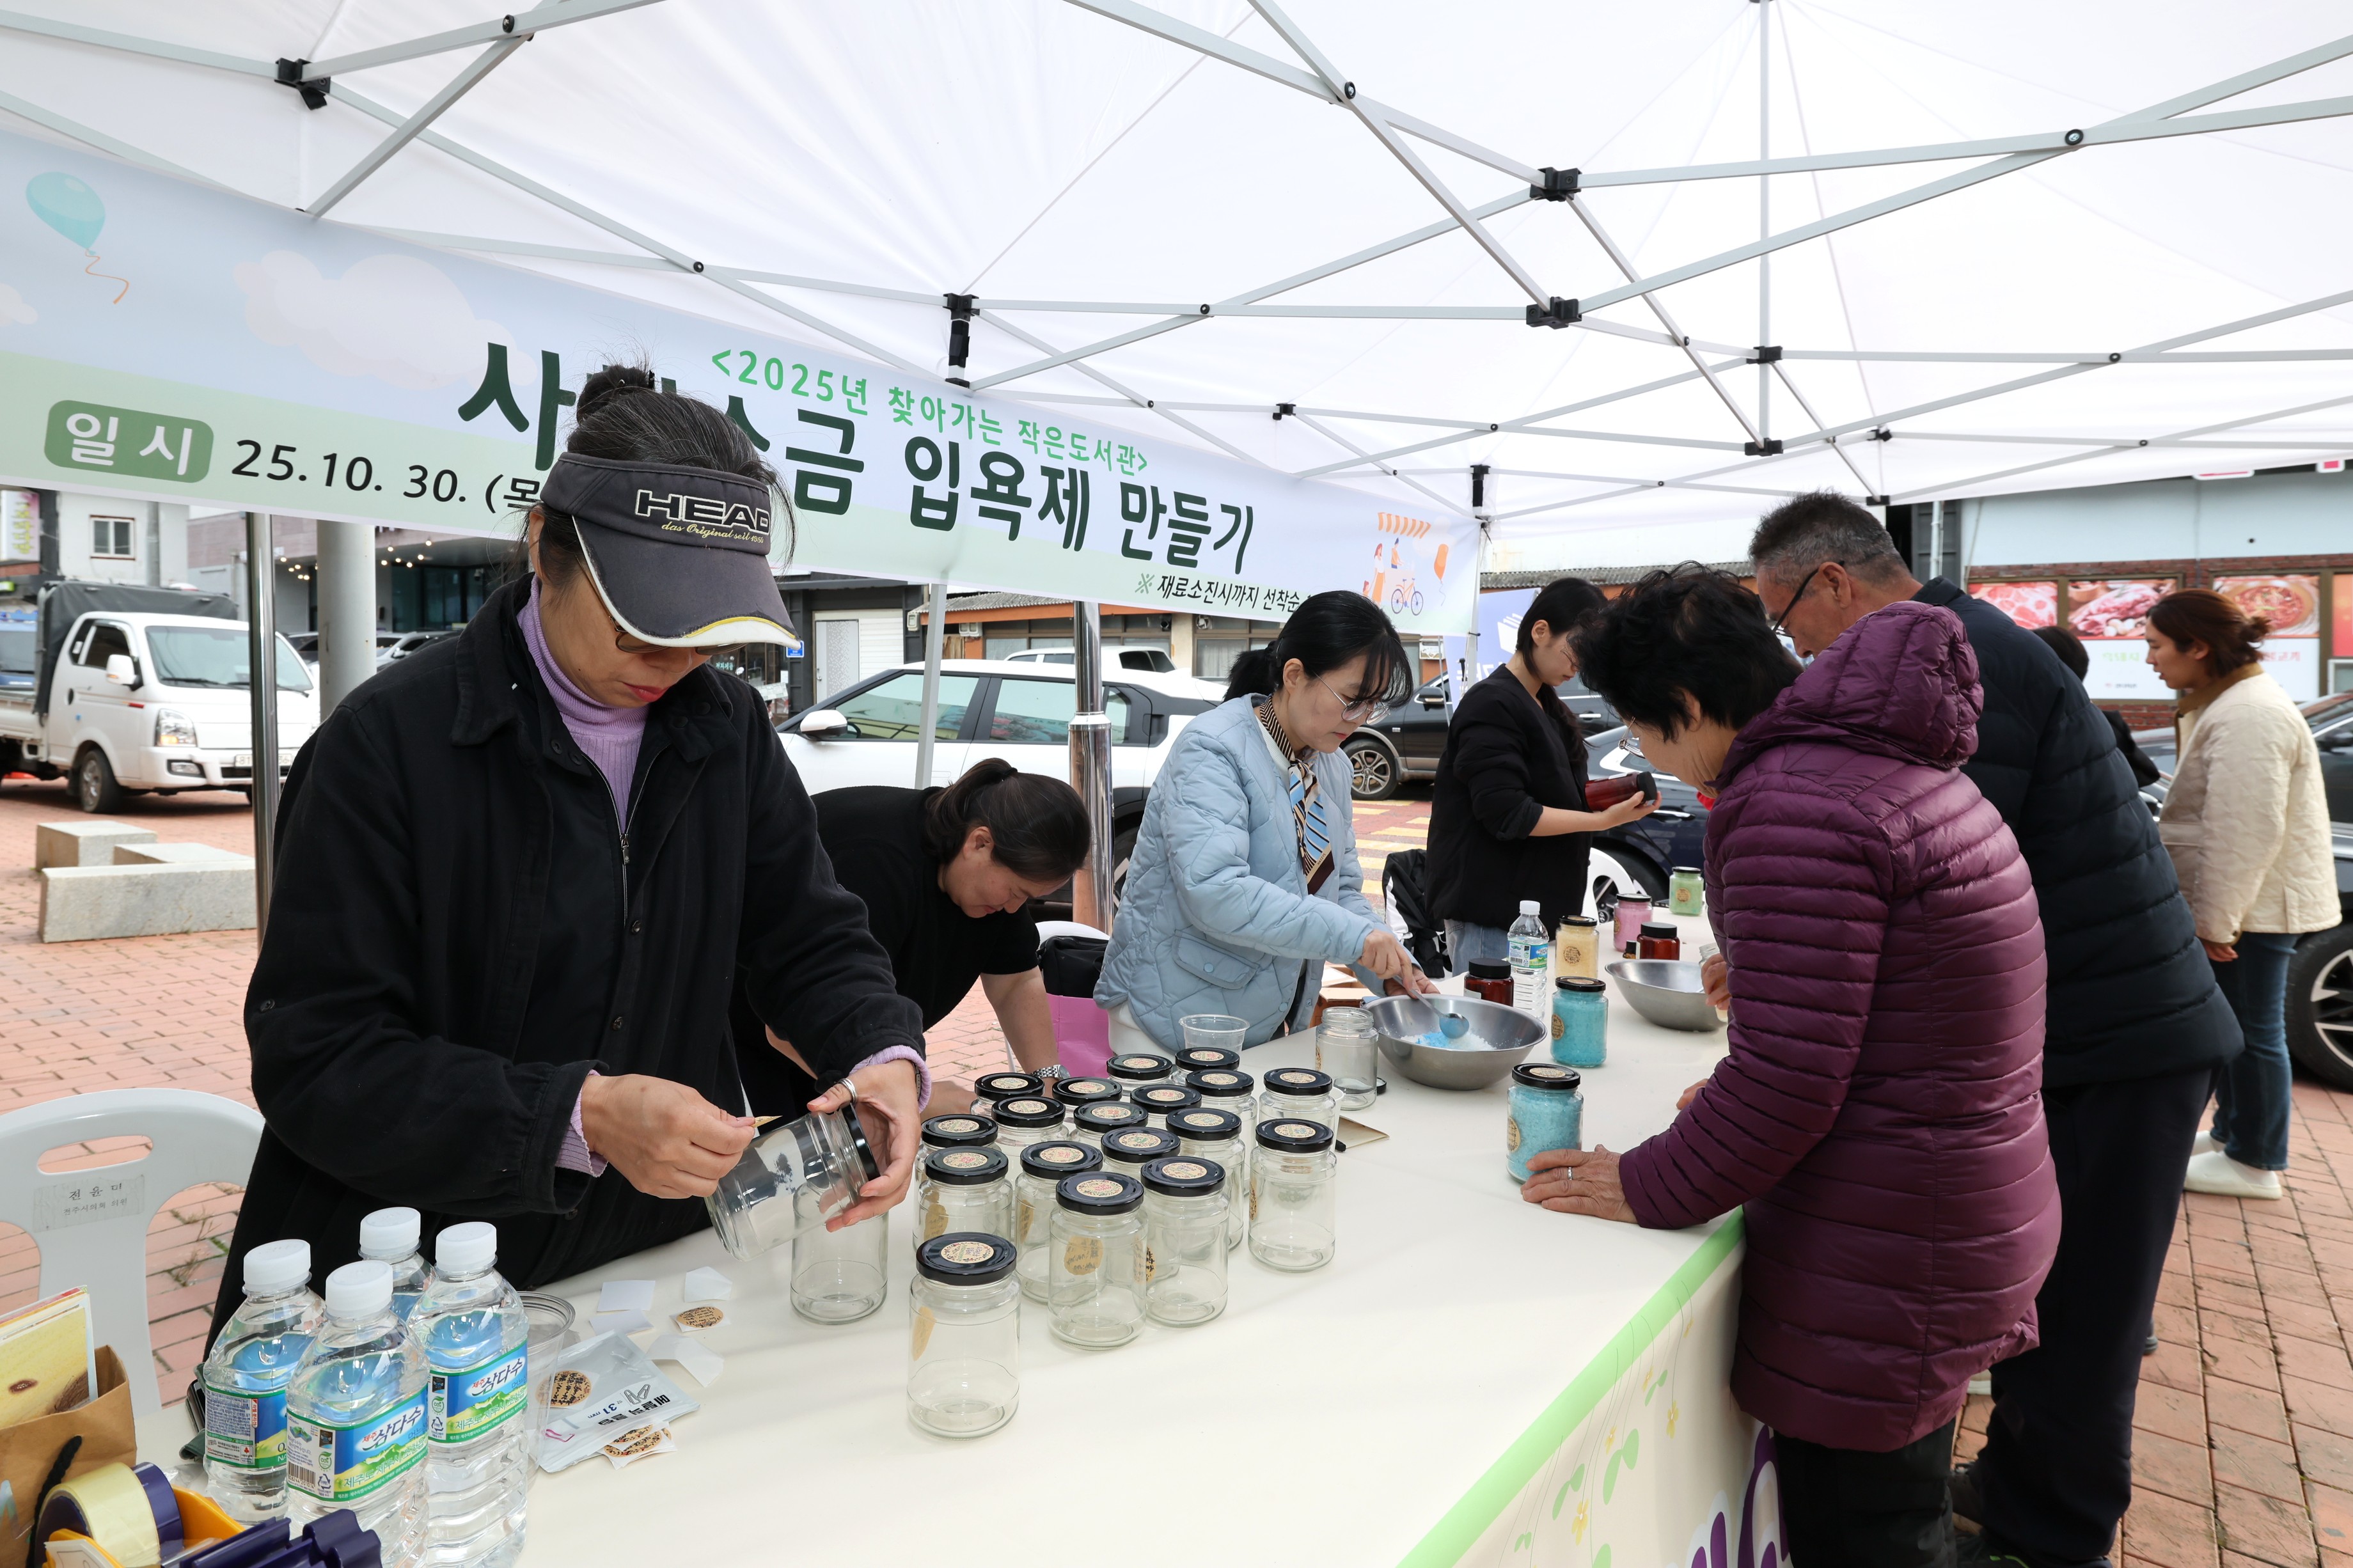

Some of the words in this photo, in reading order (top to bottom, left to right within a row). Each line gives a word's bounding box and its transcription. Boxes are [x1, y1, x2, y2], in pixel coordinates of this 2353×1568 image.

[711, 349, 869, 416] <2025년
[888, 385, 1002, 446] 찾아가는
[1018, 418, 1149, 477] 작은도서관>
[403, 464, 467, 503] 30.
[635, 489, 770, 535] HEAD
[905, 435, 1090, 553] 입욕제
[1120, 481, 1254, 575] 만들기
[661, 521, 684, 532] das
[686, 523, 734, 538] Original
[734, 531, 751, 540] seit
[750, 535, 764, 544] 1950
[1157, 575, 1259, 609] 재료소진시까지
[1263, 588, 1300, 613] 선착순
[473, 1377, 485, 1388] 제주
[481, 1358, 523, 1395] 삼다수
[455, 1414, 483, 1431] 제주도
[484, 1399, 506, 1420] 제주시
[587, 1411, 601, 1419] mm
[602, 1403, 618, 1415] 31
[628, 1394, 671, 1416] 메탈릭
[362, 1431, 377, 1443] 제주
[370, 1407, 422, 1450] 삼다수
[343, 1469, 375, 1489] 제주도
[375, 1452, 402, 1477] 제주시
